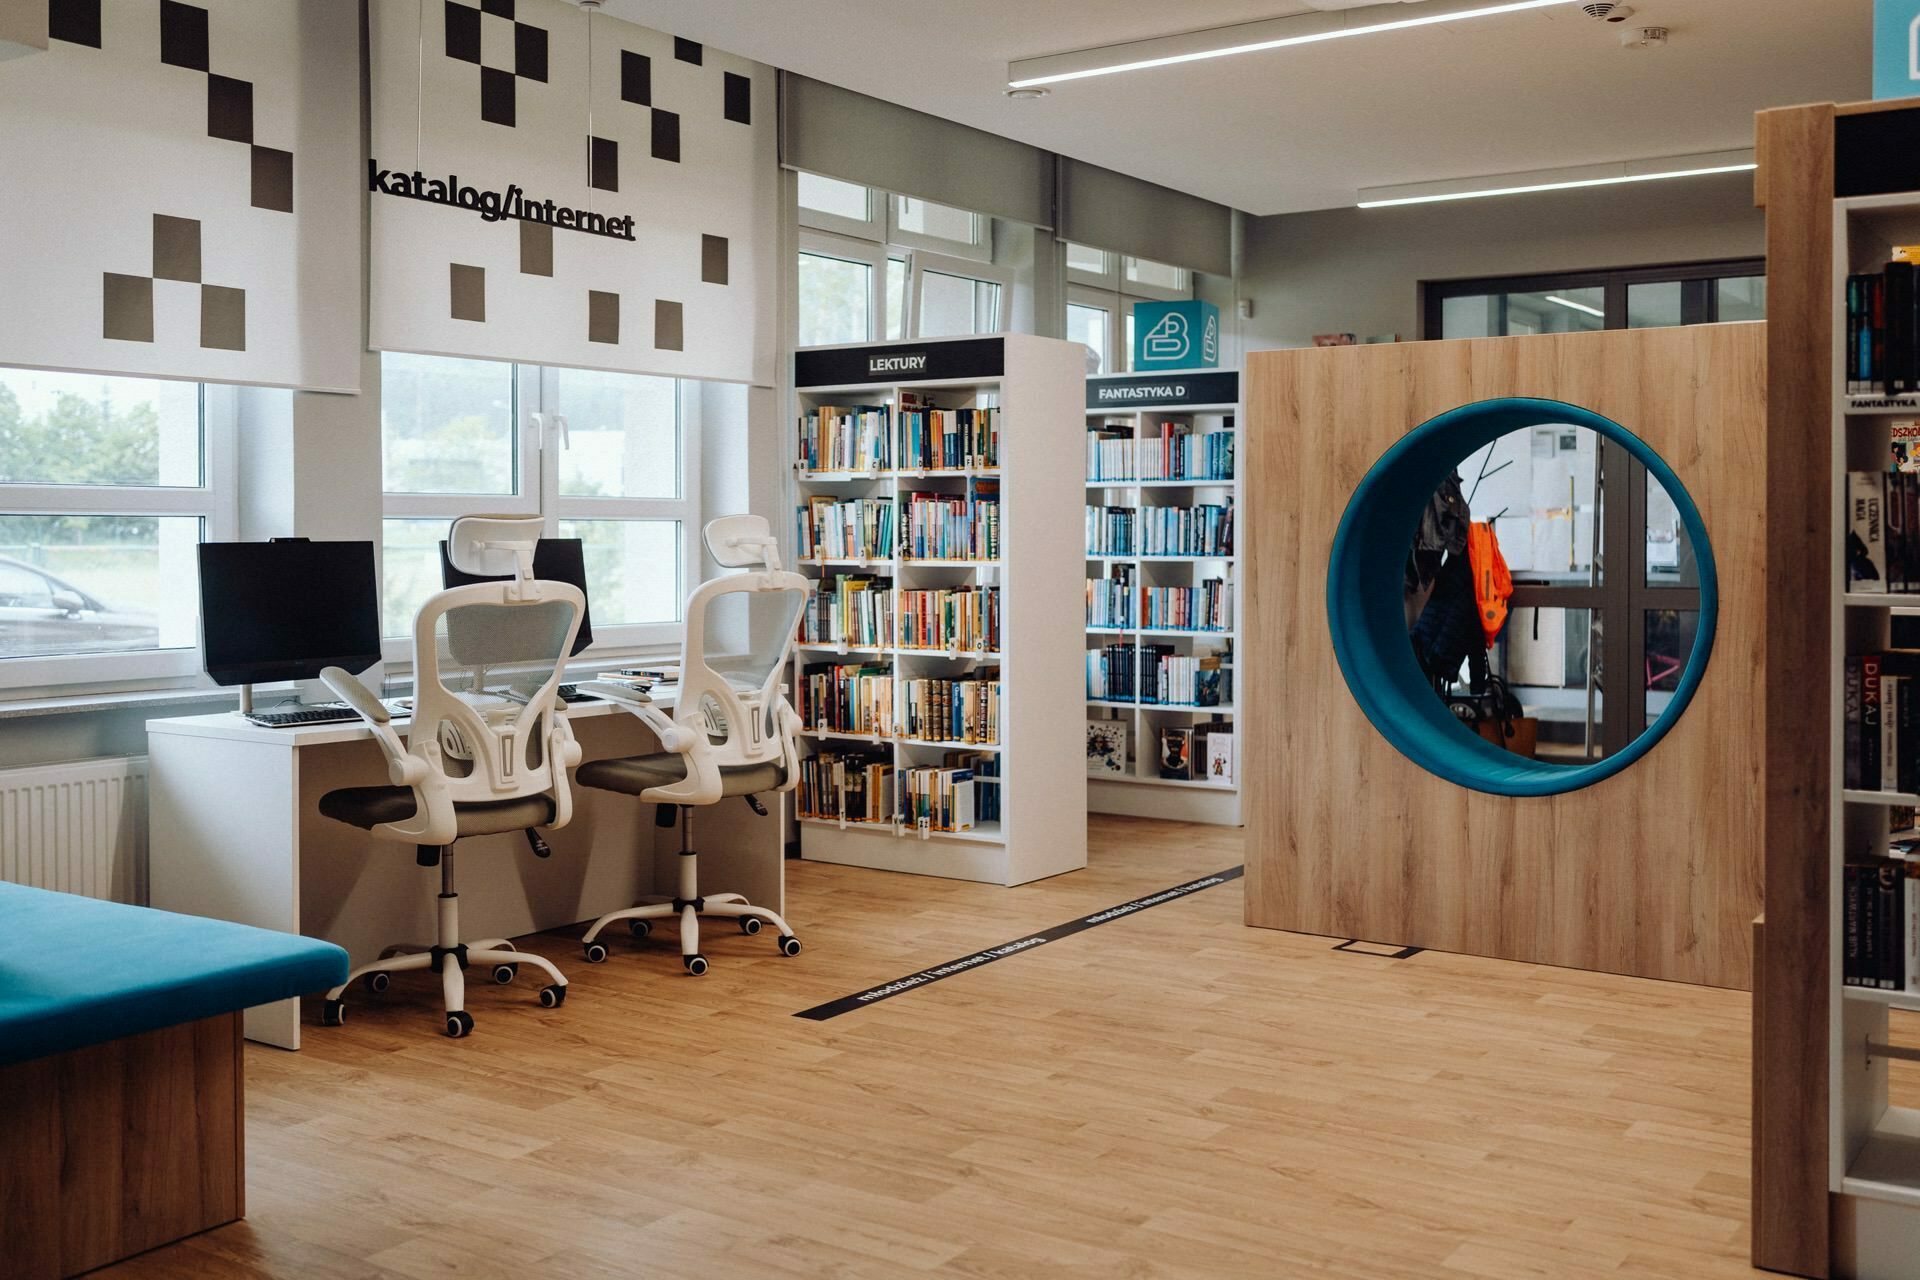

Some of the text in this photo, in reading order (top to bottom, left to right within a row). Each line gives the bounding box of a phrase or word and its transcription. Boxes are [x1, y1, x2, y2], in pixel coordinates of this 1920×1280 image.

[368, 158, 636, 241] katalog/internet
[870, 356, 926, 371] LEKTURY
[1099, 385, 1186, 399] FANTASTYKA D
[1851, 399, 1918, 408] FANTASTYKA
[1864, 663, 1878, 725] DUKAJ
[857, 976, 928, 1001] młodzież
[927, 956, 991, 975] internet
[989, 937, 1047, 955] katalog
